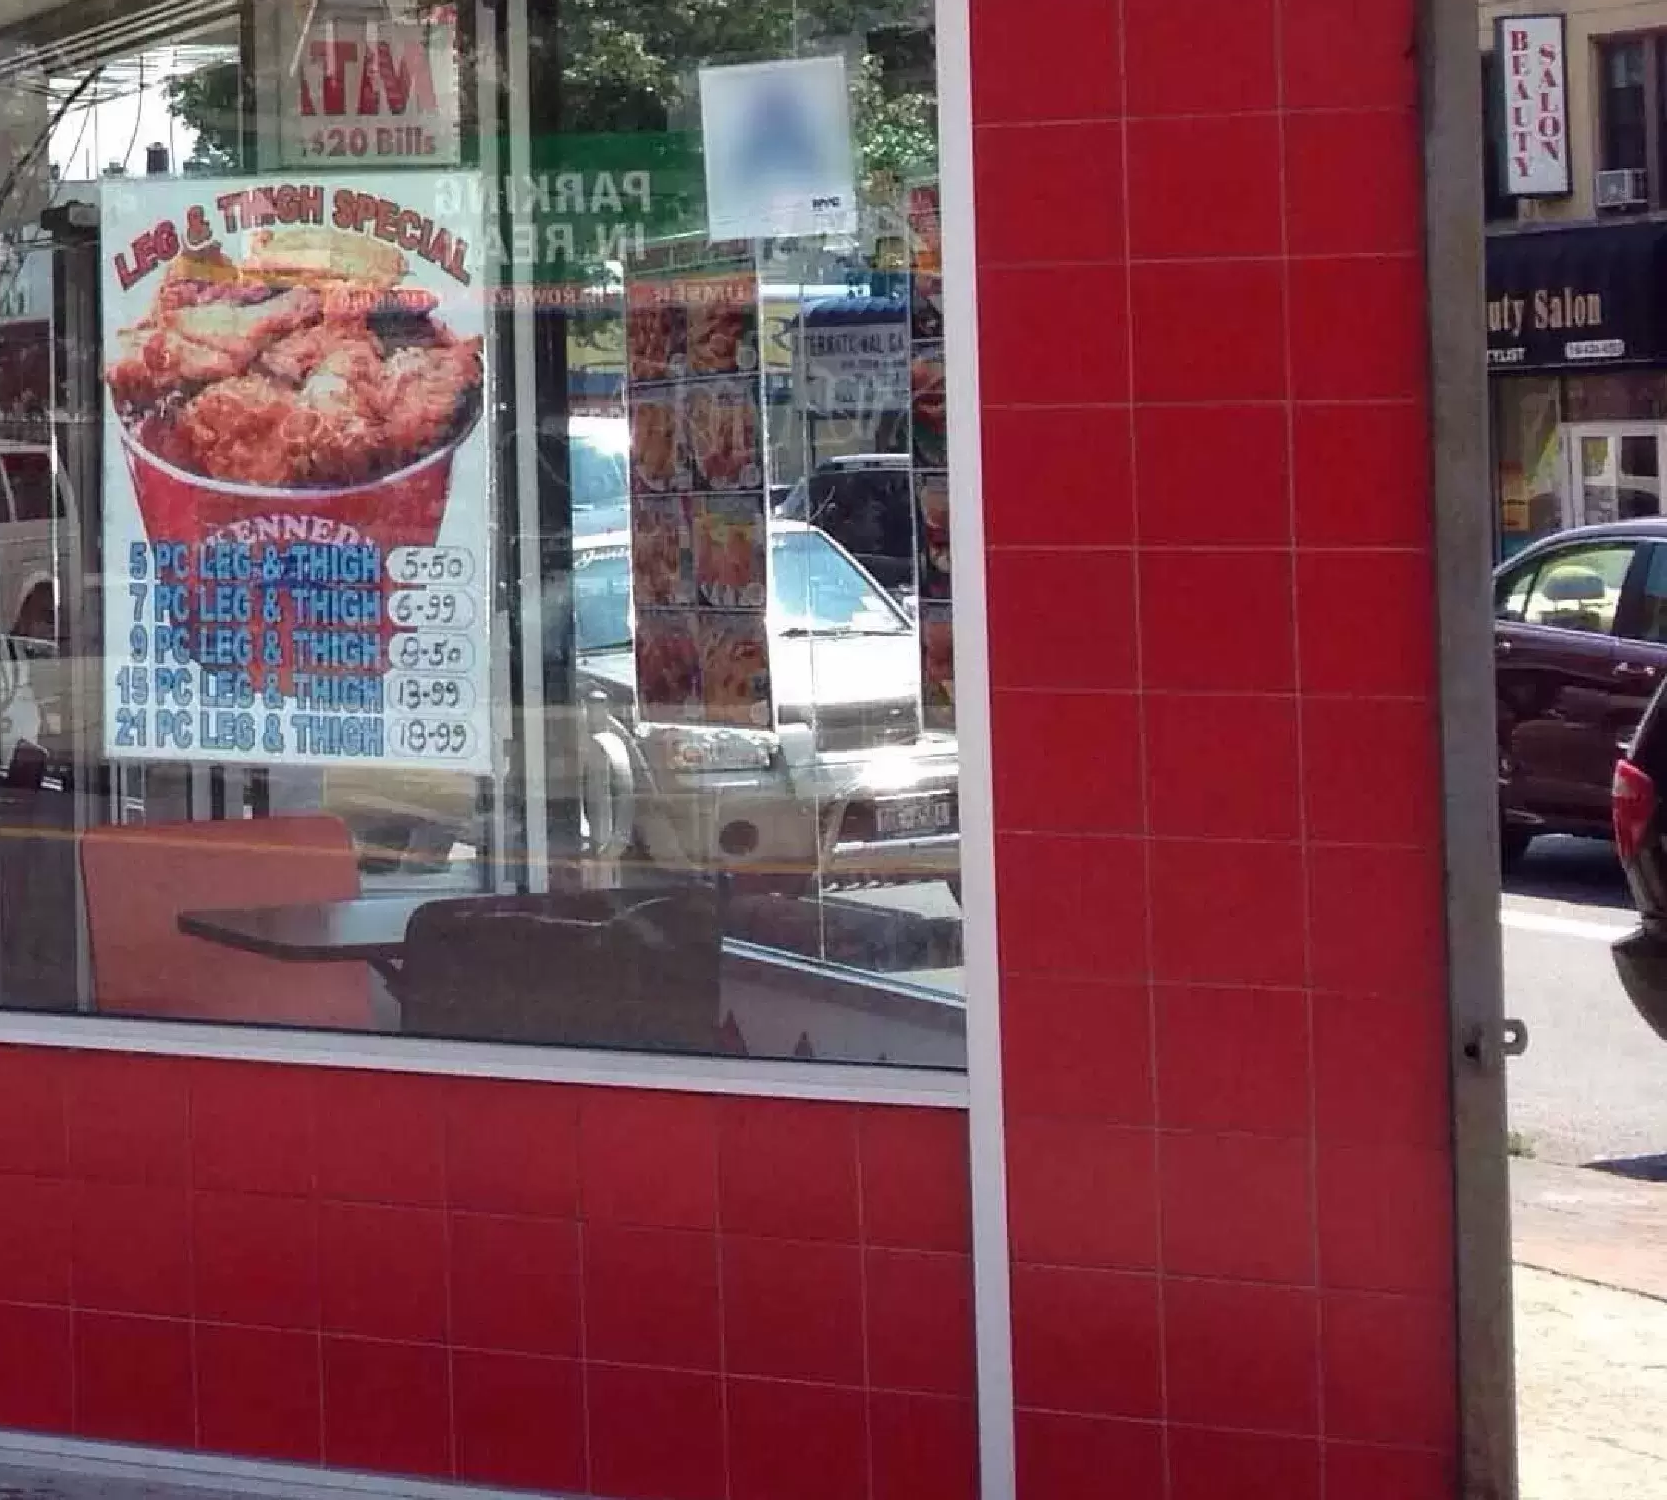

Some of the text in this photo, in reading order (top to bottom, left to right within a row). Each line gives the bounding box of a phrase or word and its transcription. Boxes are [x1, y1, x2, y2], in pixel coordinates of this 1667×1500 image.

[1511, 30, 1532, 177] BEAUTY
[1538, 44, 1560, 161] SALON
[376, 127, 436, 156] Bills
[115, 184, 471, 291] LEG & THIGH SPECIAL
[1535, 287, 1602, 329] Salon
[206, 514, 376, 547] ENNED
[129, 541, 147, 580] 5
[154, 541, 189, 579] PC
[199, 543, 251, 580] LEG
[262, 545, 282, 581] &
[291, 542, 381, 583] THIGH
[129, 584, 147, 621] 7
[154, 584, 189, 622] PC
[199, 586, 251, 622] LEG
[262, 587, 282, 623] &
[291, 588, 381, 626] THIGH
[129, 625, 147, 663] 9
[154, 626, 189, 664] PC
[199, 628, 251, 664] LEG
[262, 630, 282, 665] &
[291, 630, 381, 668] THIGH
[116, 666, 148, 706] 15
[154, 667, 192, 706] PC
[199, 670, 254, 709] LEG
[262, 672, 283, 709] &
[291, 672, 384, 714] THIGH
[115, 707, 148, 747] 21
[154, 709, 192, 749] PC
[199, 711, 254, 751] LEG
[262, 714, 283, 753] &
[291, 716, 384, 758] THIGH
